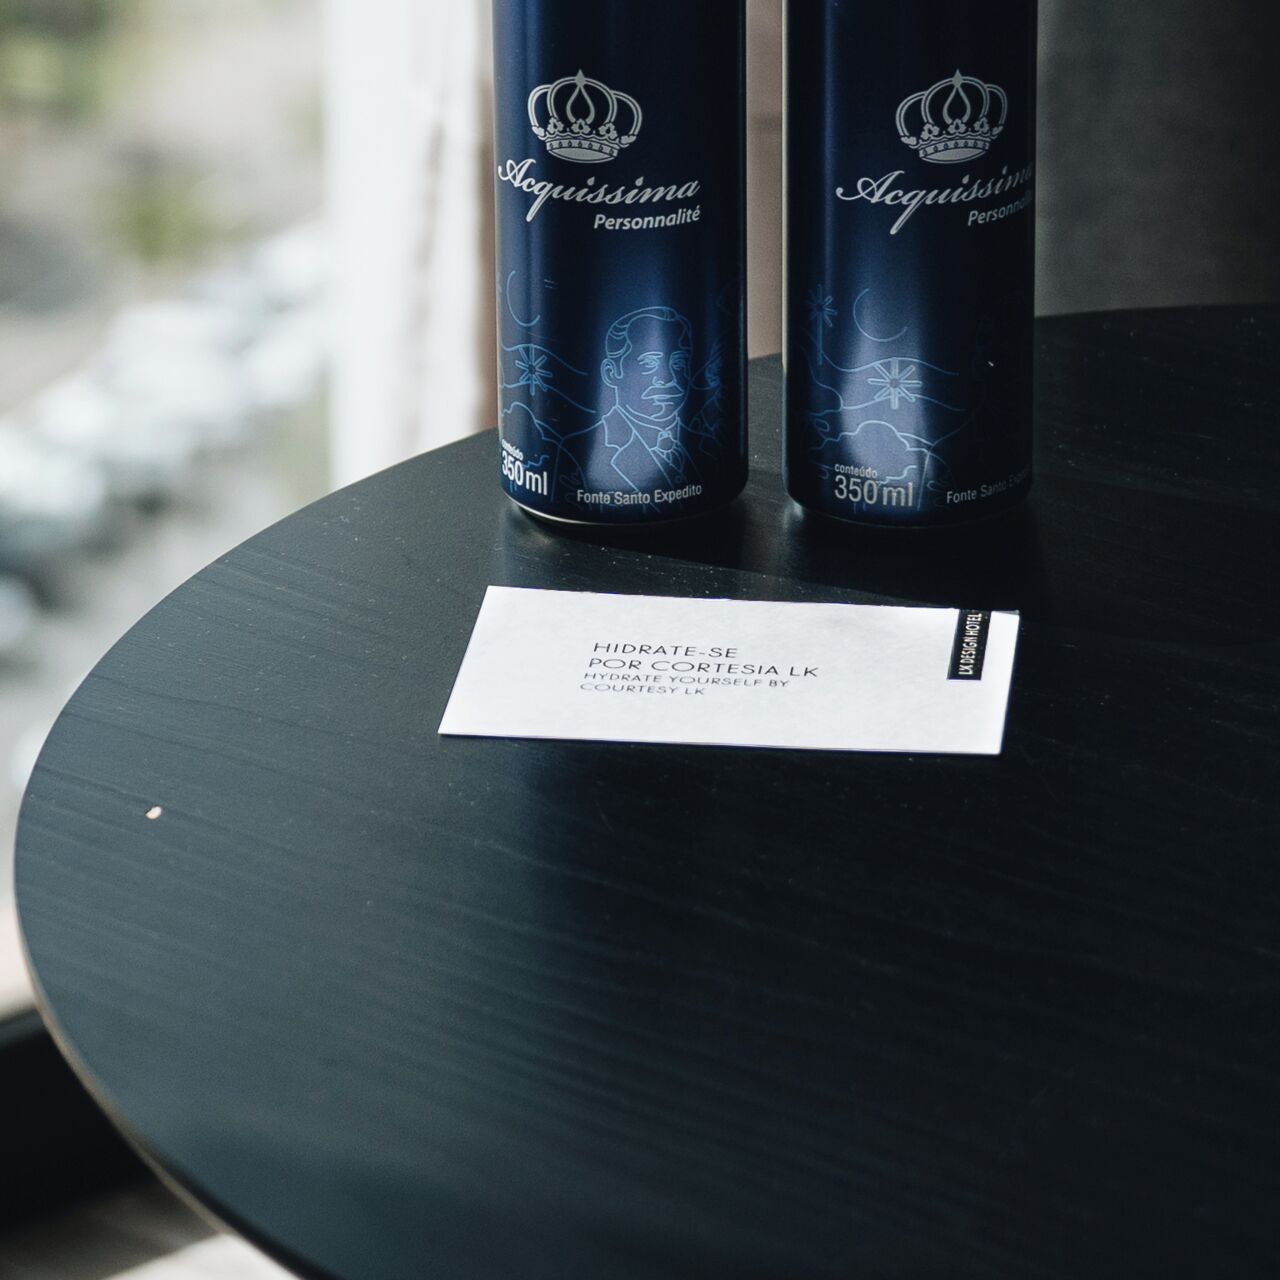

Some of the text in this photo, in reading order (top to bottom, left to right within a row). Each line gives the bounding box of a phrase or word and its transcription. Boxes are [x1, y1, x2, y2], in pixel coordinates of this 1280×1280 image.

[498, 158, 701, 222] Acquissima
[594, 204, 701, 230] Personnalité
[502, 450, 548, 496] 350 ml
[834, 463, 878, 479] conteúdo
[577, 484, 702, 506] Fonte Santo Expedito
[834, 475, 914, 507] 350 ml
[946, 490, 977, 504] Fonte
[593, 642, 739, 659] HIDRATE-SE
[958, 613, 983, 675] LK DESIGN HOTEL
[588, 658, 820, 678] POR CORTESIA LK
[579, 682, 706, 696] COURTESY LK
[583, 672, 790, 688] HYDRATE YOURSELF BY
